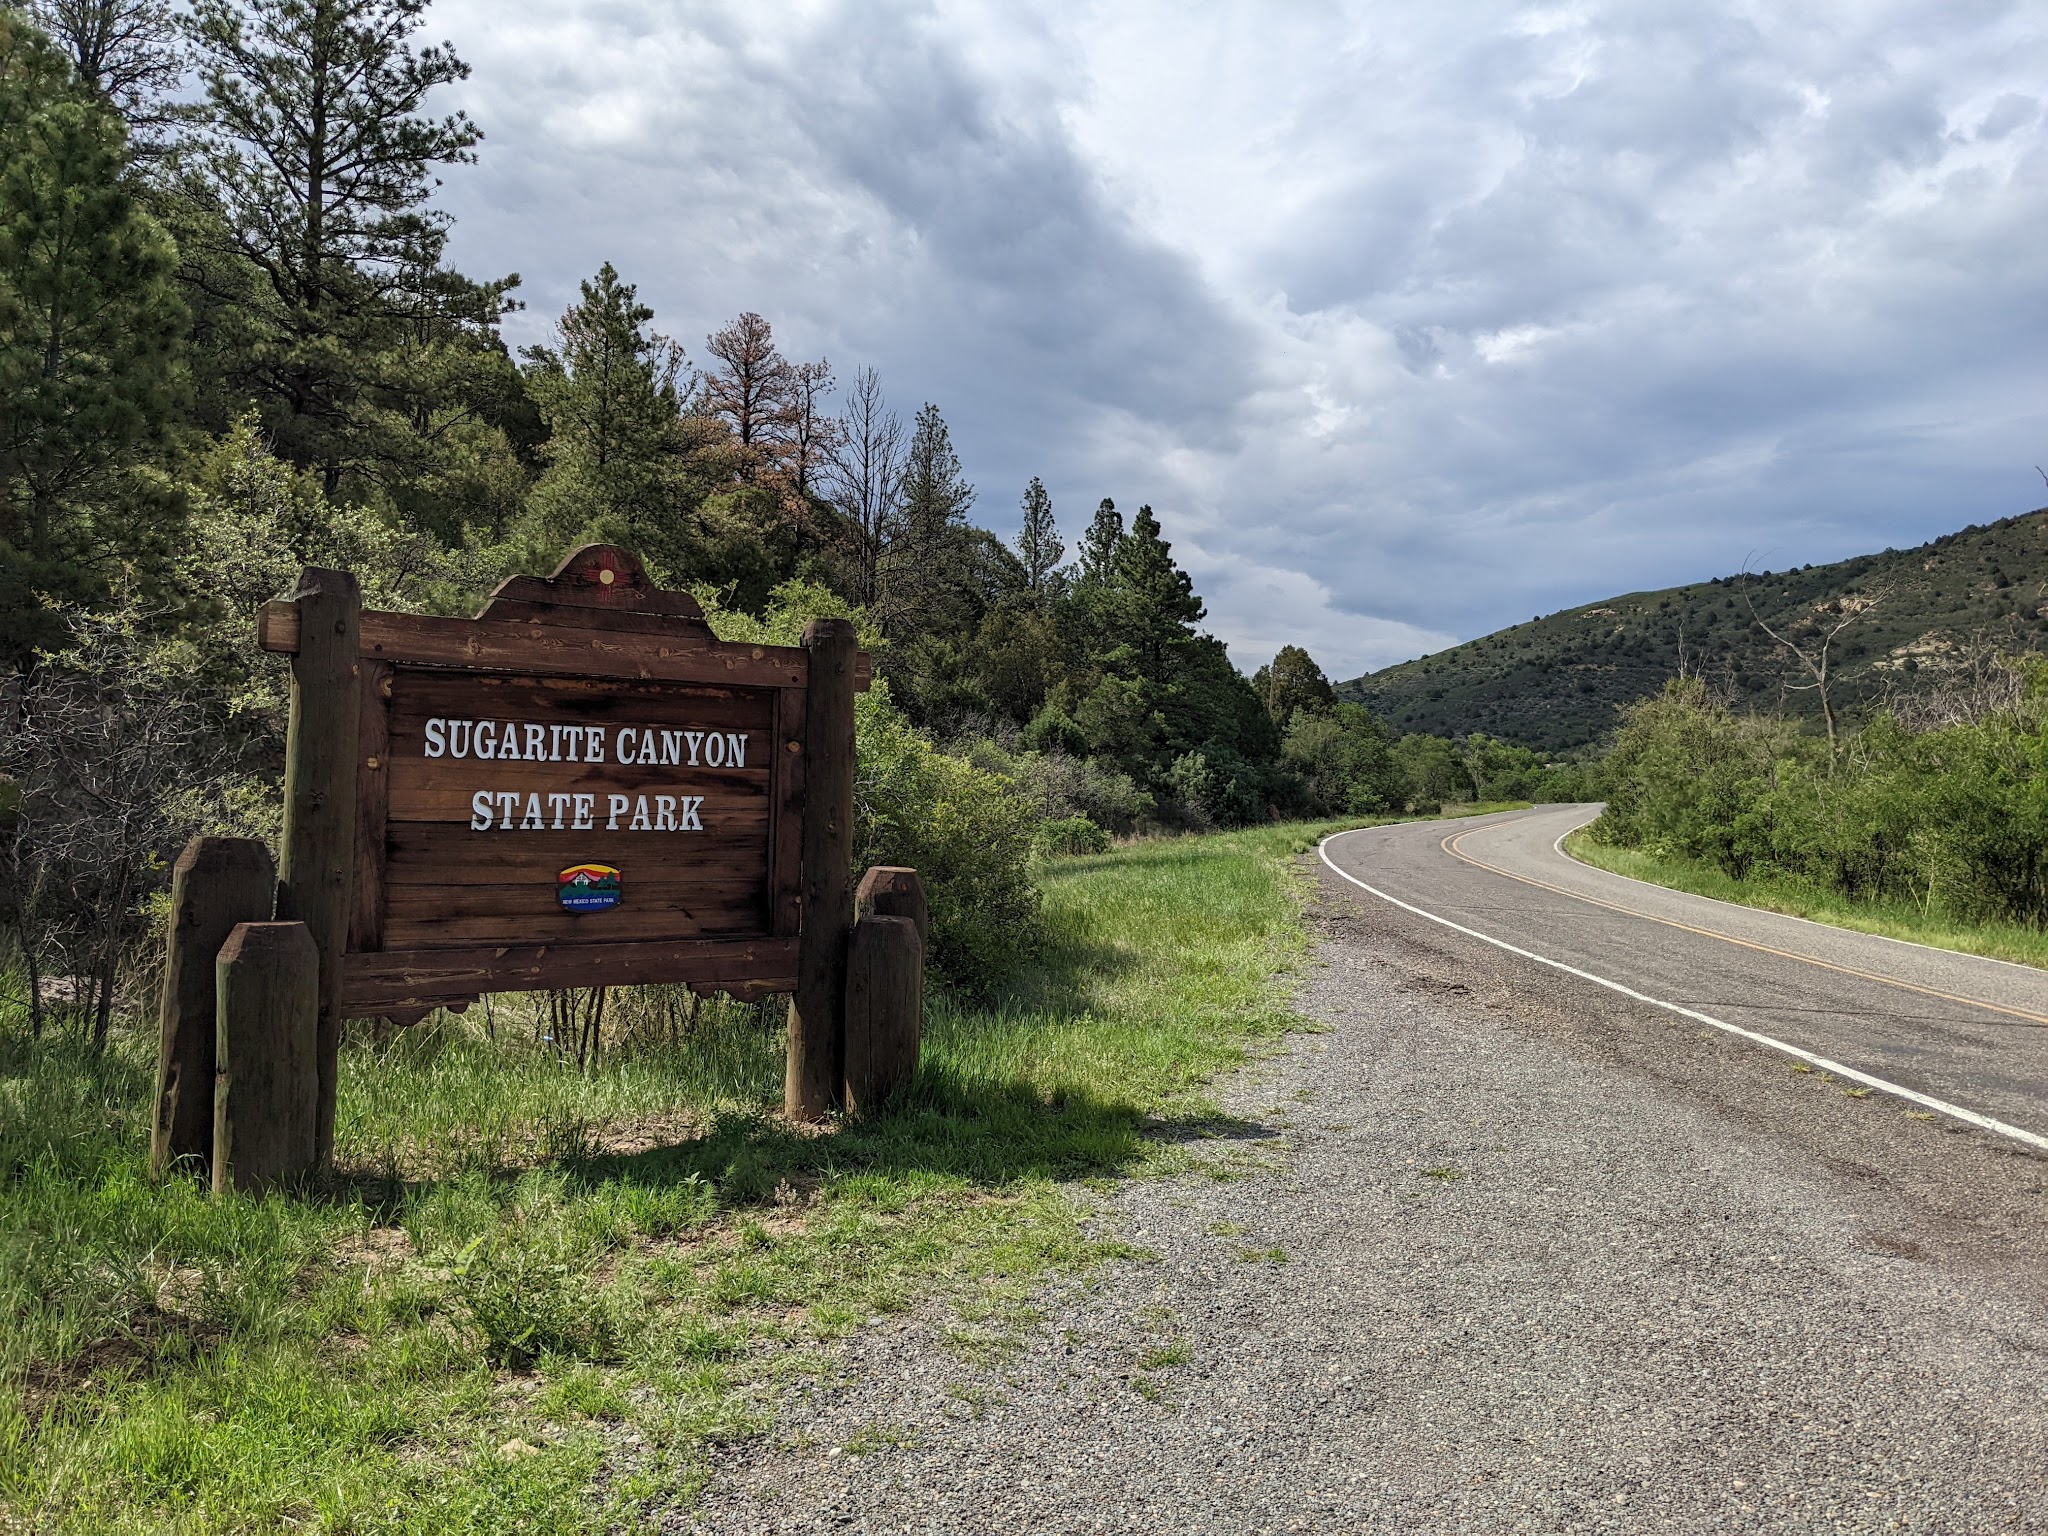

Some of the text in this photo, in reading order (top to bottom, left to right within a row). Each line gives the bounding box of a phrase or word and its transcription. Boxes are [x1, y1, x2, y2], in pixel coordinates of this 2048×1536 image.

[424, 718, 748, 768] SUGARITE CANYON
[471, 790, 705, 832] STATE PARK
